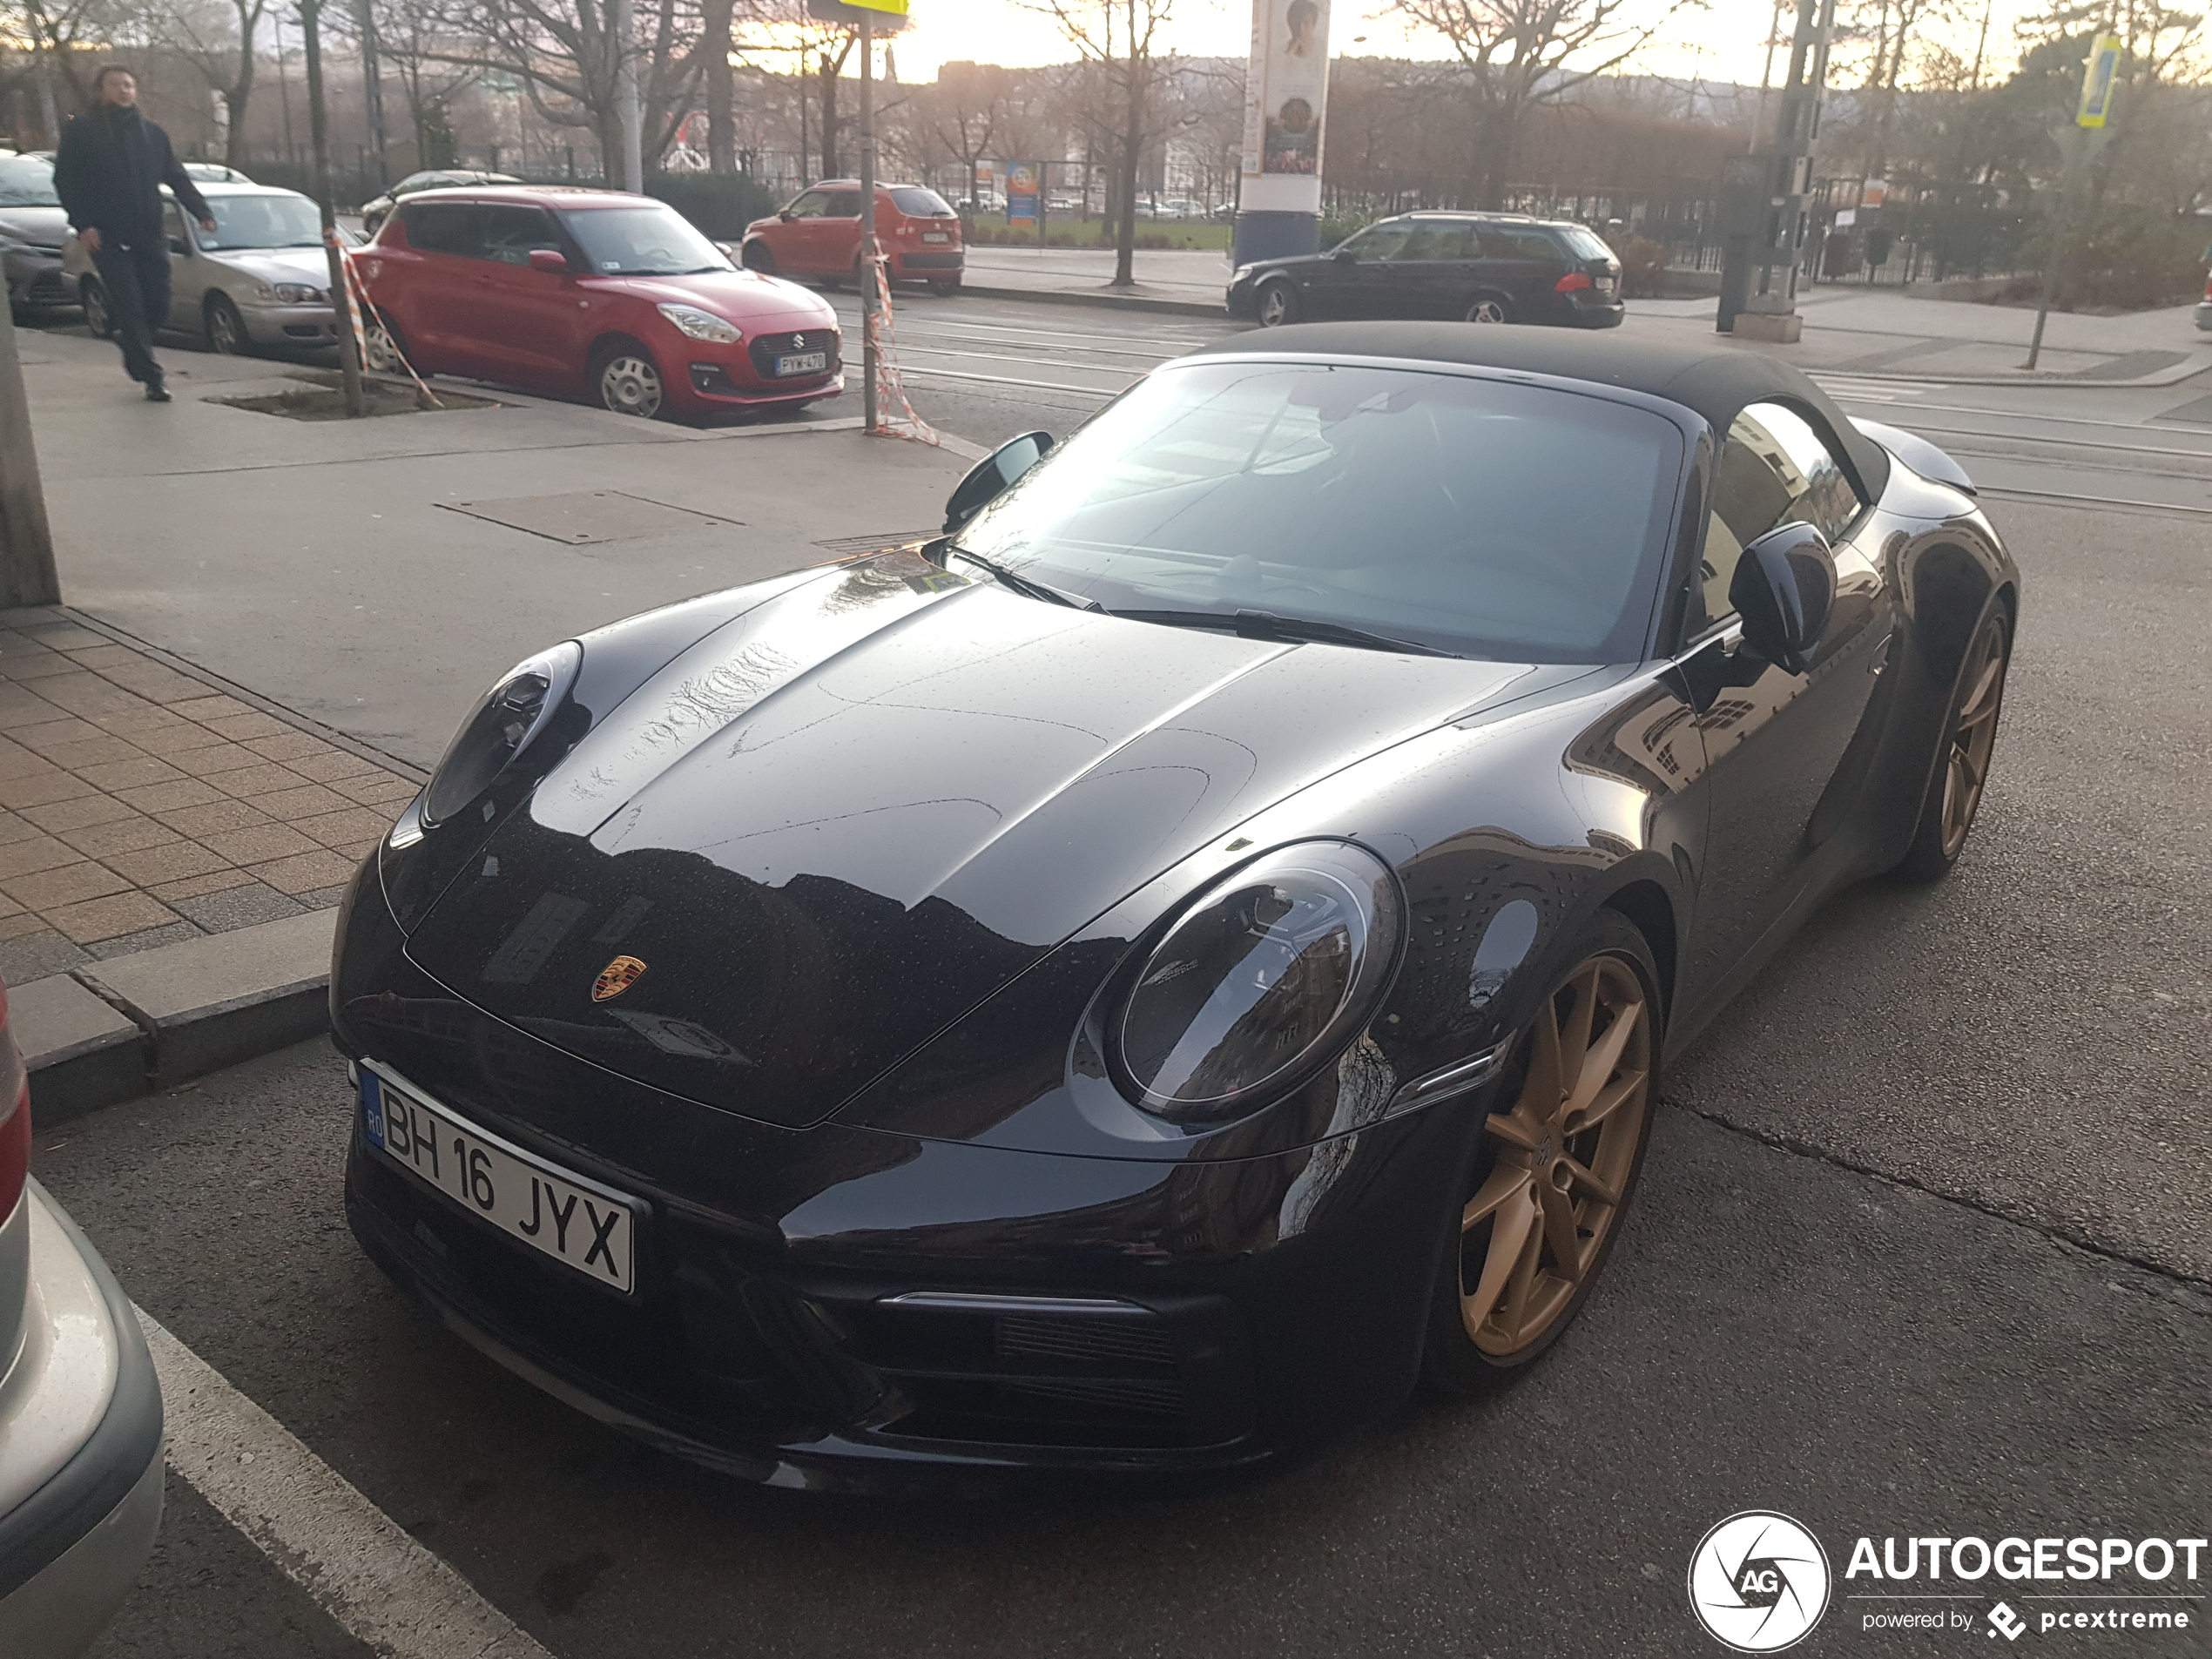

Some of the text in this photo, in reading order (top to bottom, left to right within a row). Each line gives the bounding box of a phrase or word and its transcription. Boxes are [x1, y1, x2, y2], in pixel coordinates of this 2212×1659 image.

[617, 957, 646, 971] PORSCHE
[368, 1109, 384, 1139] RO
[383, 1088, 620, 1278] BH 16 JYX
